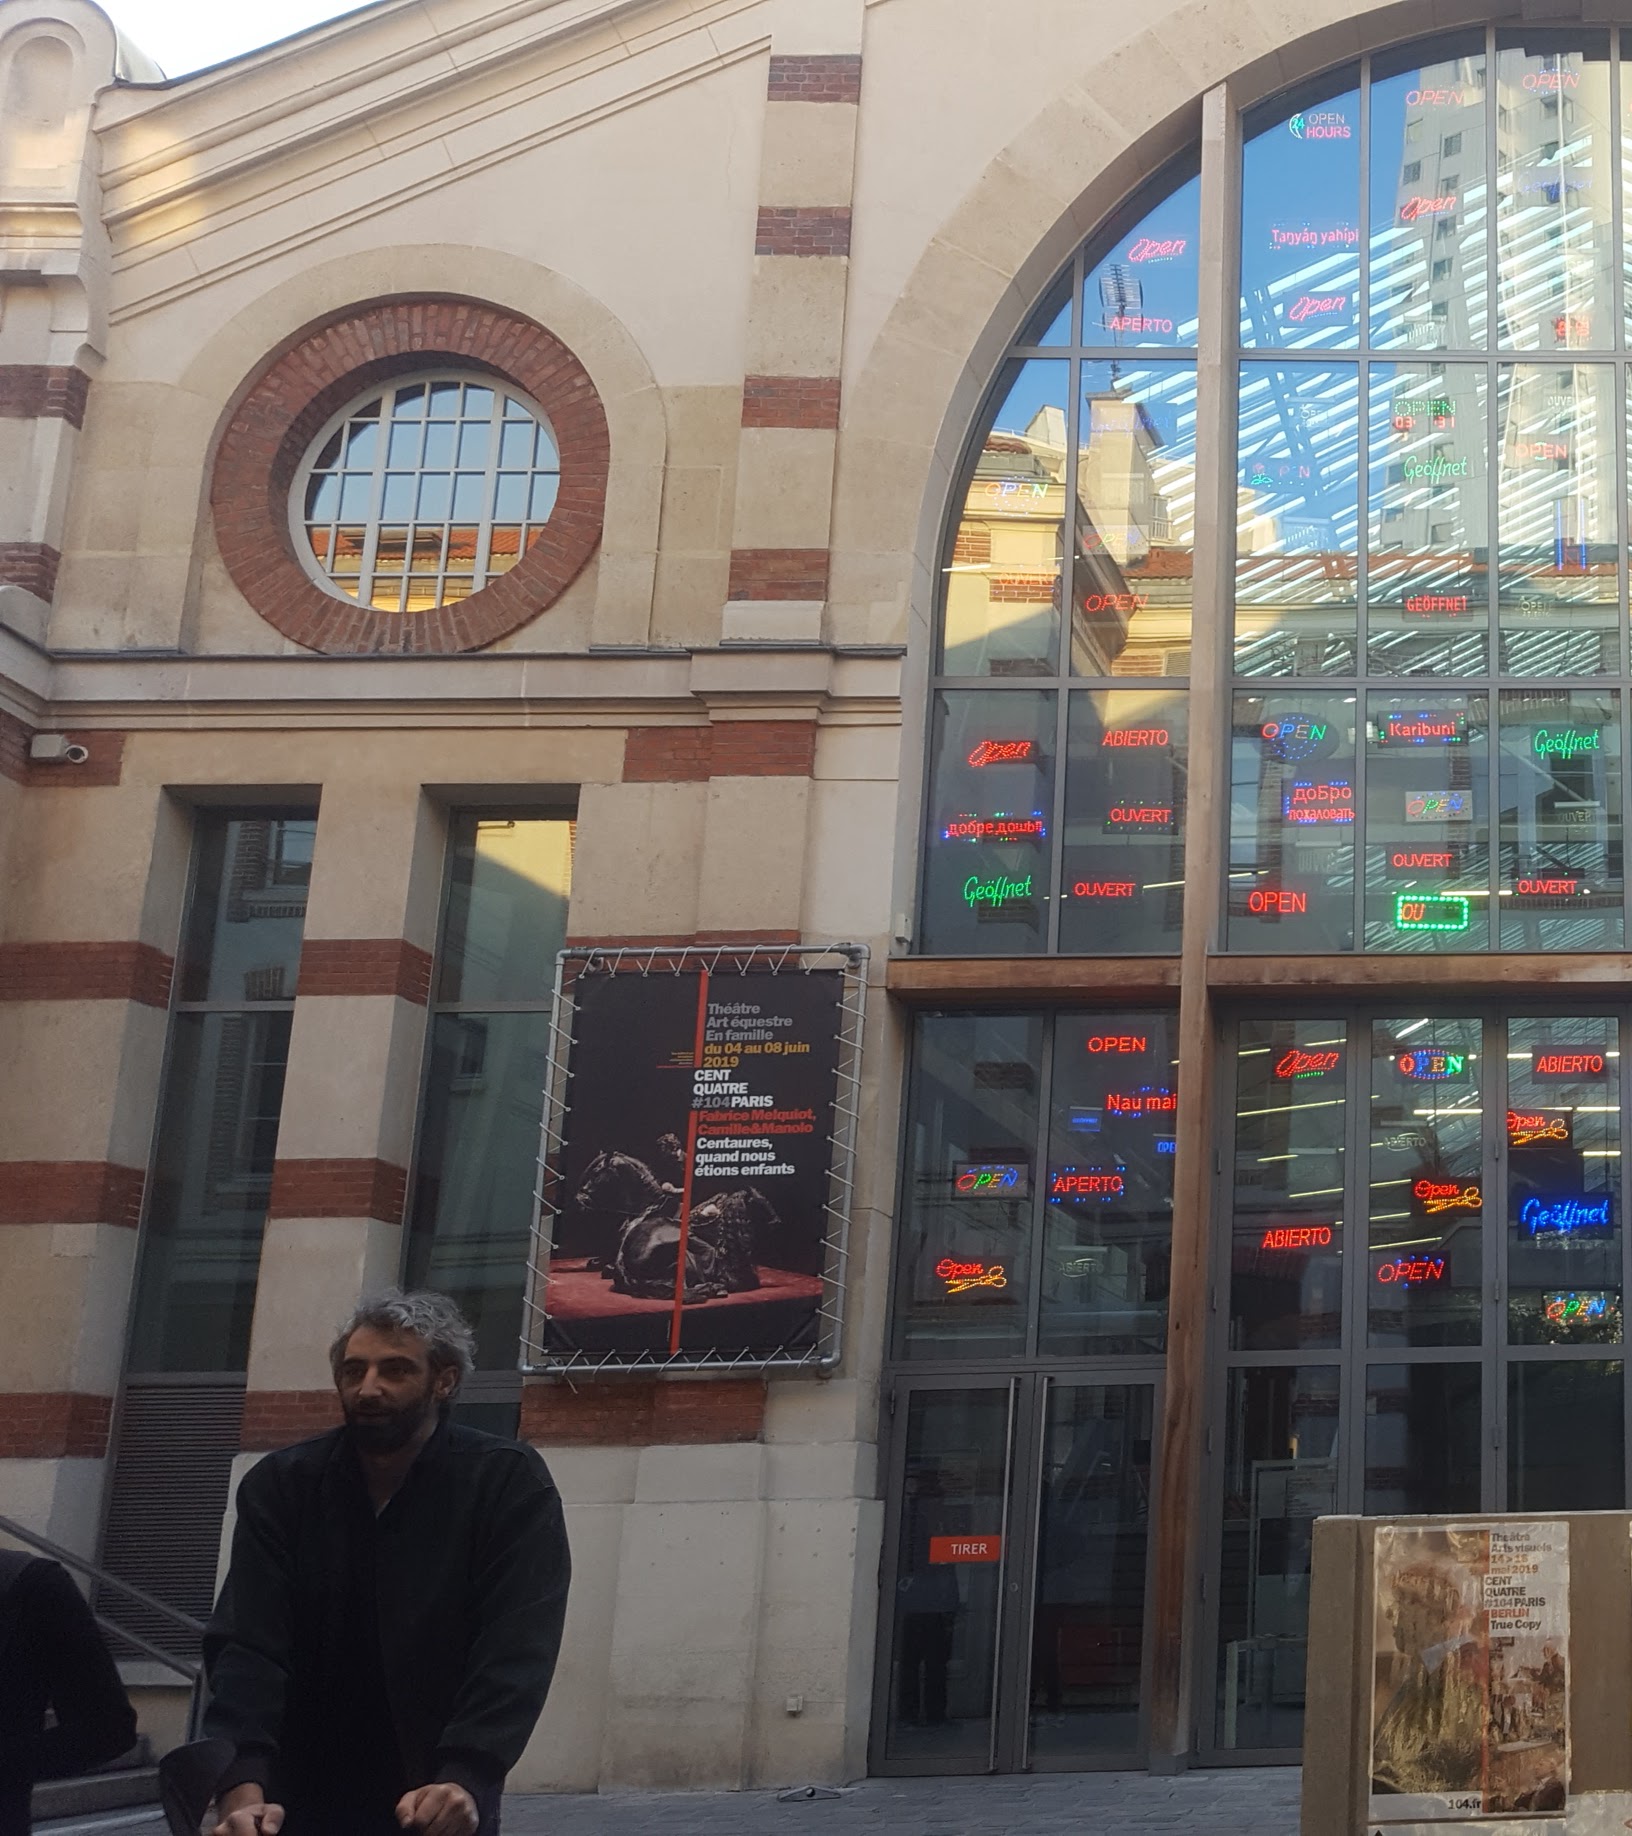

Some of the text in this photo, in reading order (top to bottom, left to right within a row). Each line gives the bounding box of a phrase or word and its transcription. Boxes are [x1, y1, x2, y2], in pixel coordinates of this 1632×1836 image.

[1522, 74, 1580, 90] OPEN
[1405, 90, 1464, 106] OPEN
[1309, 113, 1345, 125] OPEN
[1306, 126, 1351, 139] HOURS
[1401, 196, 1457, 221] Open
[1128, 238, 1187, 264] Open
[1289, 296, 1346, 322] Open
[1110, 318, 1173, 334] APERTO
[1394, 400, 1456, 417] OPEN
[1515, 444, 1568, 459] OPEN
[1404, 455, 1468, 484] Geöffnet
[985, 482, 1047, 499] OPEN
[1086, 594, 1148, 613] OPEN
[1406, 594, 1468, 613] GEÖFFNET
[1262, 723, 1327, 740] OPEN
[1389, 721, 1456, 737] Karibuni
[1102, 730, 1169, 747] ABIERTO
[1534, 729, 1600, 760] Geöffnet
[967, 741, 1031, 768] Open
[1406, 798, 1463, 814] OPEN
[1110, 808, 1172, 823] OUVERT
[1392, 853, 1453, 867] OUVERT
[964, 875, 1032, 907] Geöffnet
[1074, 882, 1136, 897] OUVERT
[1517, 880, 1578, 894] OUVERT
[1249, 891, 1307, 913] OPEN
[707, 1002, 761, 1016] Théâtre
[706, 1015, 793, 1030] Art équestre
[705, 1029, 773, 1042] En famille
[704, 1042, 810, 1056] du 04 au 08 juin
[1088, 1036, 1147, 1052] OPEN
[703, 1056, 739, 1068] 2019
[1275, 1050, 1339, 1078] Open
[1400, 1055, 1464, 1075] OPEN
[1536, 1054, 1604, 1073] ABIERTO
[694, 1069, 731, 1081] CENT
[692, 1083, 749, 1095] QUATRE
[1107, 1093, 1177, 1110] Nau mai
[698, 1109, 817, 1122] Fabrice Melquiot,
[1506, 1111, 1545, 1130] Open
[696, 1137, 773, 1150] Centaures,
[695, 1151, 776, 1167] quand nous
[694, 1163, 795, 1176] étions enfants
[957, 1169, 1018, 1191] OPEN
[1052, 1175, 1124, 1193] APERTO
[1415, 1180, 1460, 1199] Open
[1520, 1197, 1611, 1236] Geöffnet
[1262, 1227, 1332, 1249] ABIERTO
[936, 1258, 983, 1279] Open
[1378, 1260, 1445, 1283] OPEN
[1546, 1298, 1606, 1320] OPEN
[951, 1543, 987, 1555] TIRER
[1512, 1564, 1539, 1574] 2019
[1484, 1576, 1512, 1586] CENT
[1484, 1586, 1527, 1597] QUATRE
[1491, 1608, 1530, 1618] BERLIN
[1490, 1619, 1542, 1630] True Copy
[1448, 1799, 1481, 1811] 104.fr
